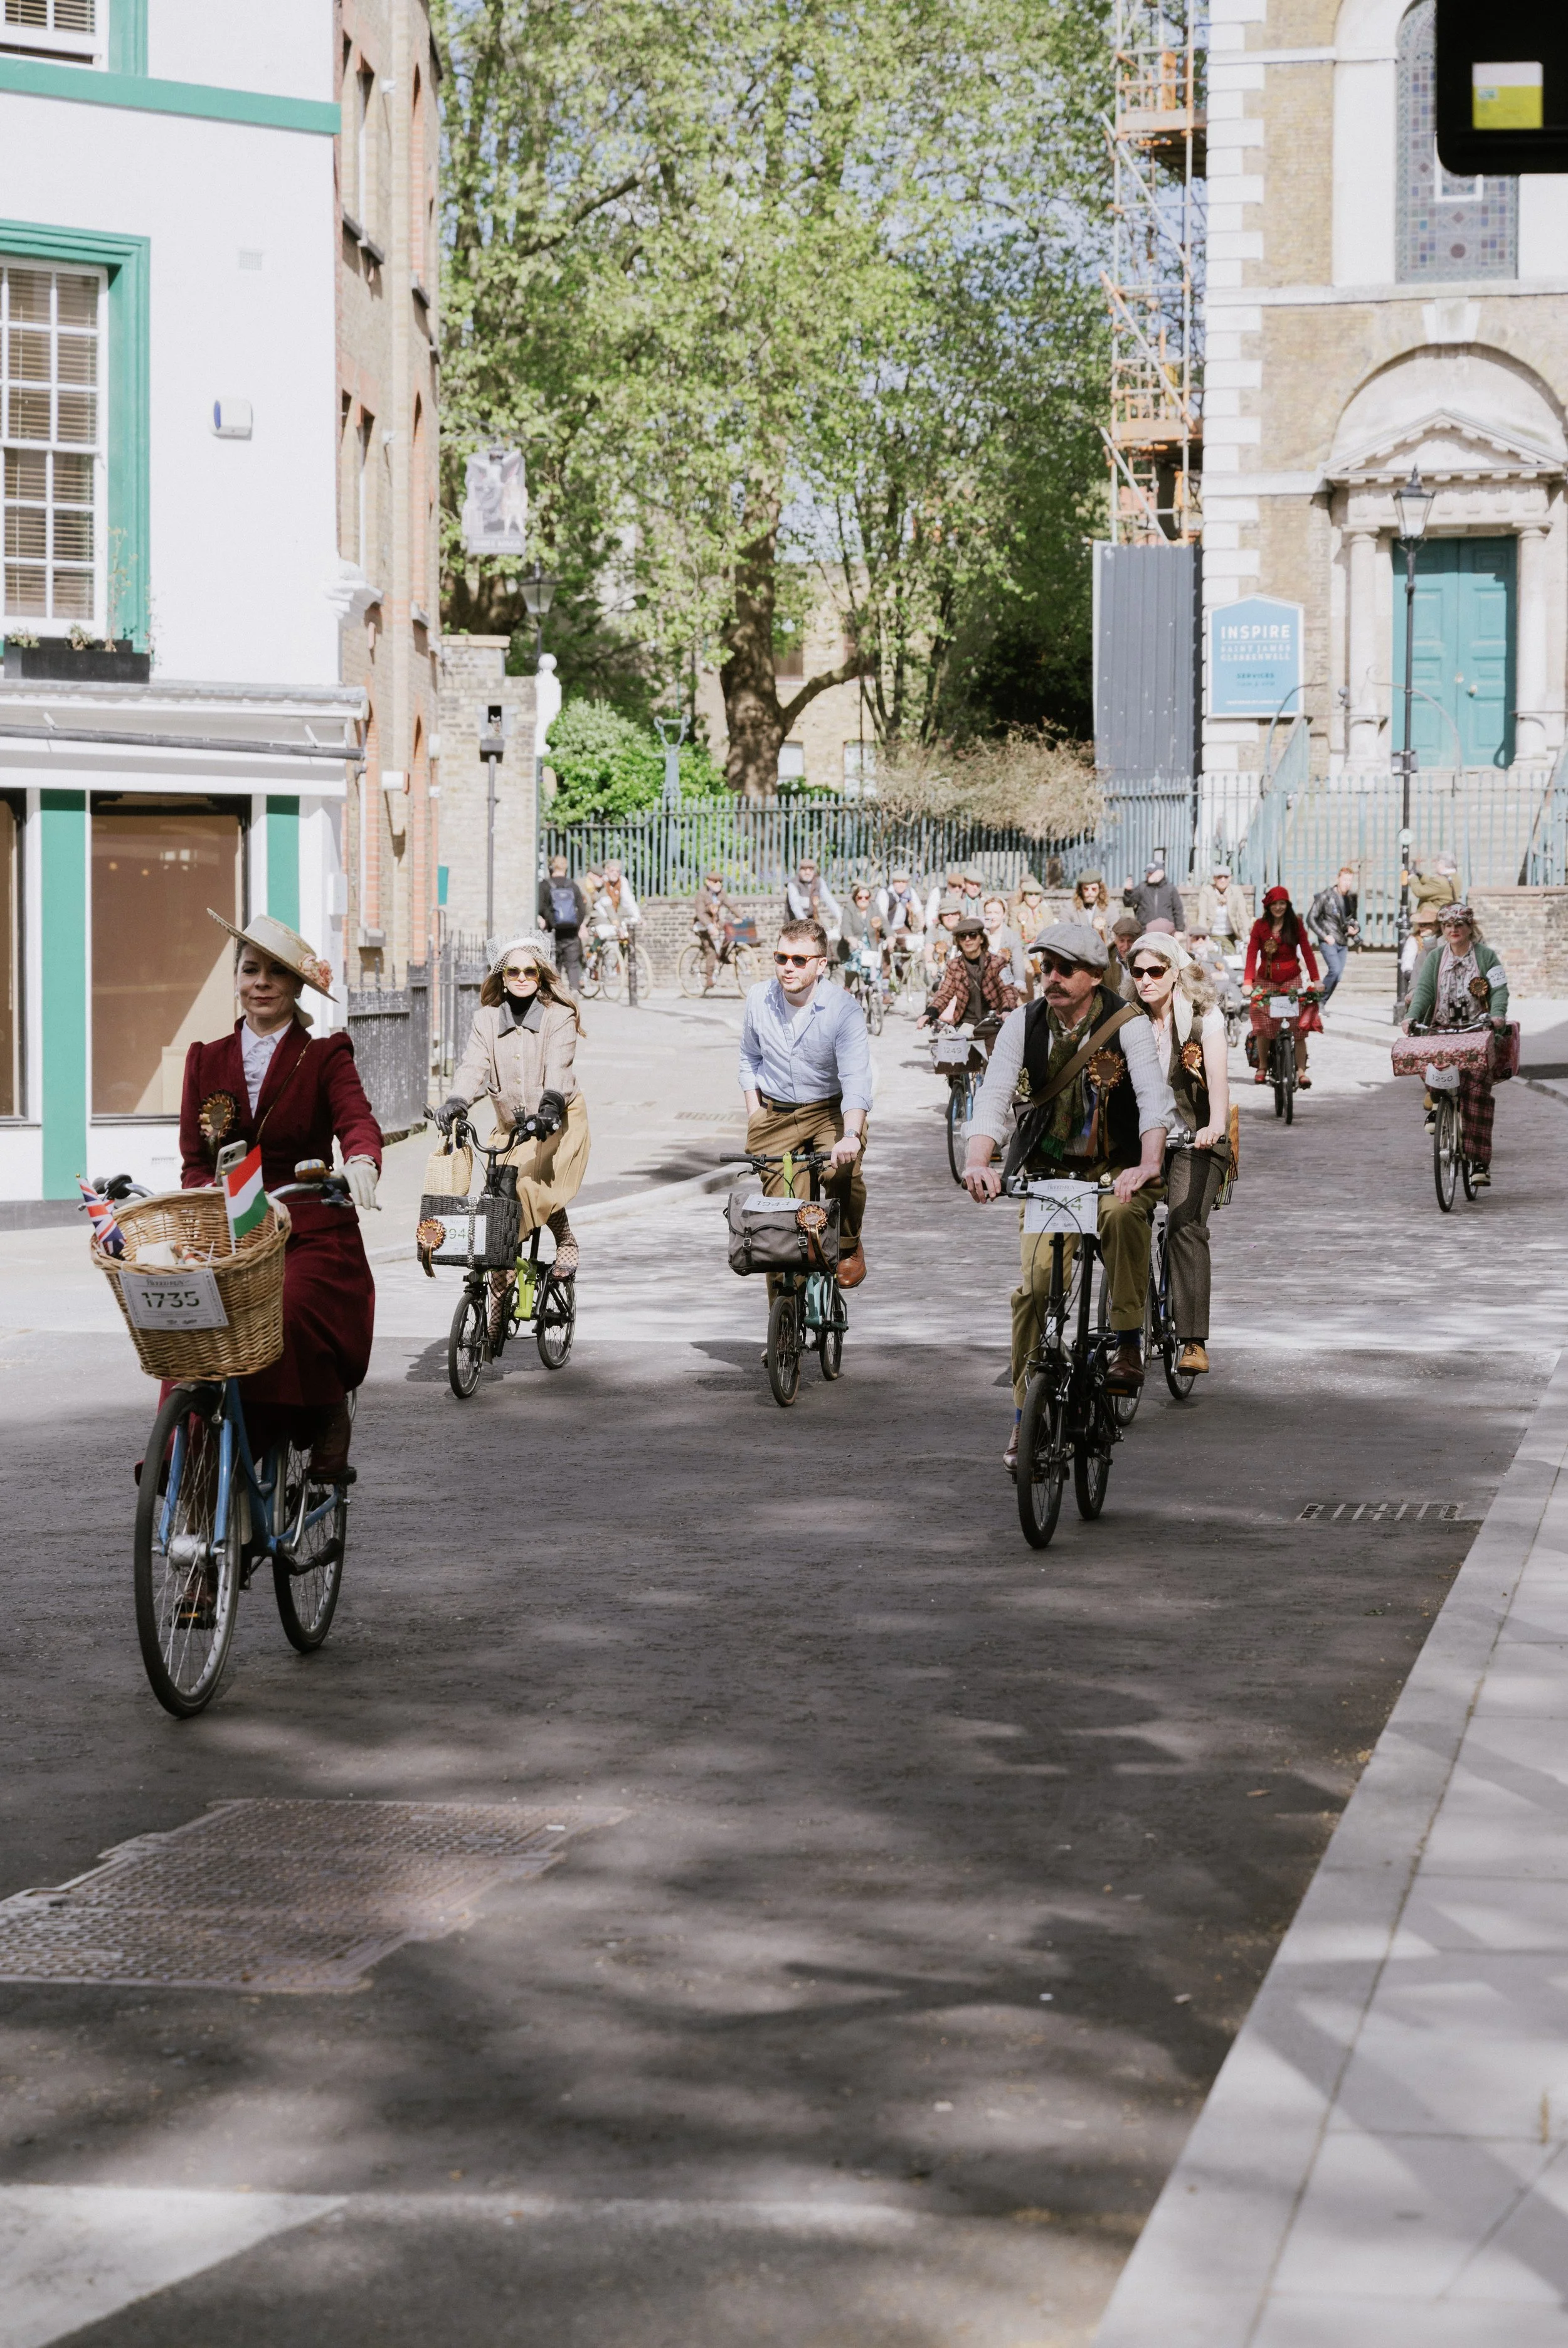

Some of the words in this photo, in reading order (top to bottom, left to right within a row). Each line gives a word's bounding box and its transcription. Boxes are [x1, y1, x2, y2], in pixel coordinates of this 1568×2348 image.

[1221, 624, 1291, 639] INSPIRE
[1432, 1074, 1453, 1082] 1250
[141, 1291, 200, 1308] 1735
